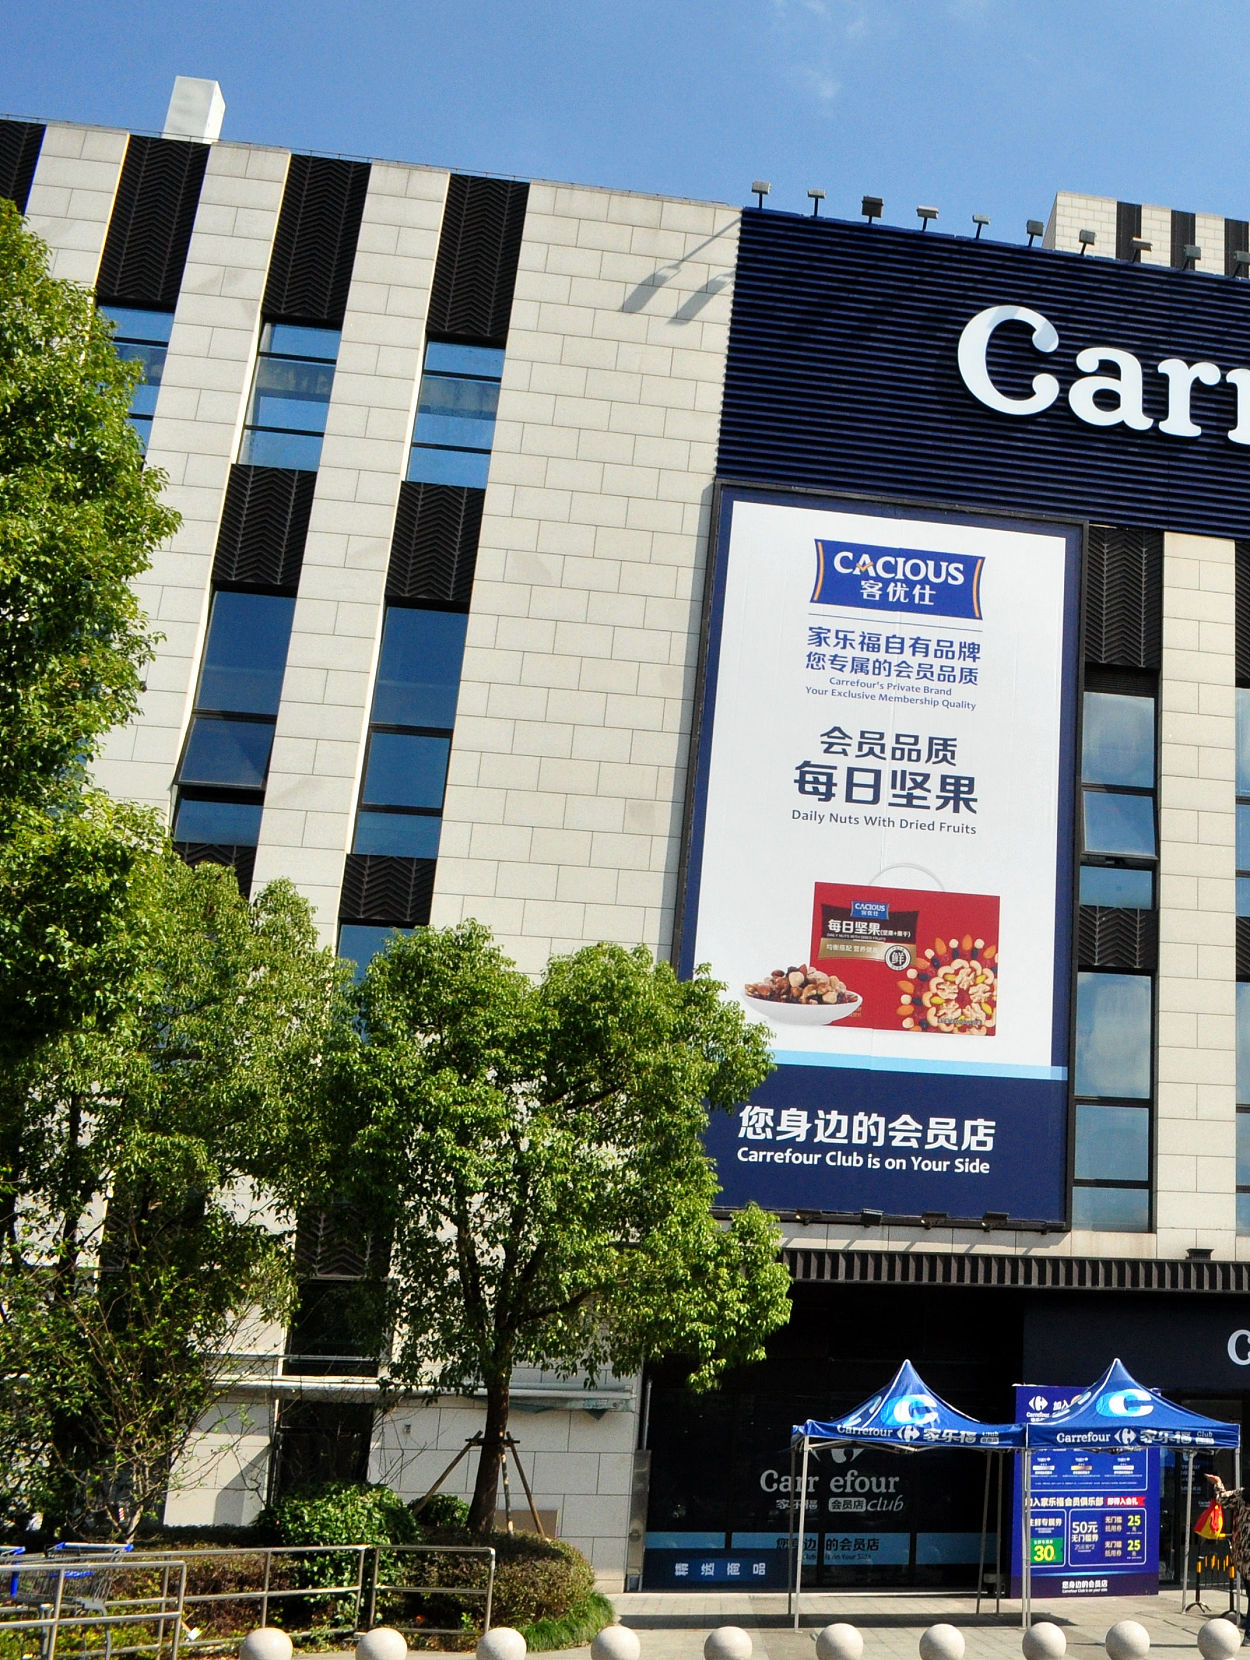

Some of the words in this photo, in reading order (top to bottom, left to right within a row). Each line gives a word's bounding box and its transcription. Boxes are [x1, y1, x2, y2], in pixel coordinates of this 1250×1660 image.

[833, 551, 964, 585] CACIOUS
[860, 579, 936, 606] 客优仕
[807, 627, 981, 663] 家乐福自有品牌
[806, 652, 979, 686] 您专属的会员品质
[829, 677, 884, 690] Carrefour's
[887, 683, 921, 693] Private
[923, 686, 951, 696] Brand
[806, 686, 828, 696] Your
[831, 689, 875, 700] Exclusive
[879, 694, 939, 707] Membership
[942, 700, 976, 711] Quality
[820, 726, 958, 766] 会员品质
[793, 760, 978, 815] 每日坚果
[792, 810, 824, 823] Daily
[830, 813, 859, 825] Nuts
[864, 816, 895, 828] With
[900, 819, 935, 831] Dried
[940, 822, 976, 834] Fruits
[855, 903, 885, 911] CACIOUS
[828, 919, 881, 936] 每日坚果
[738, 1105, 996, 1152] 您身边的会员店
[737, 1147, 821, 1165] Carrefour
[826, 1151, 863, 1167] Club
[868, 1154, 880, 1169] is
[885, 1158, 906, 1170] on
[911, 1156, 950, 1172] Your
[954, 1158, 989, 1174] Side
[837, 1425, 893, 1437] Carrefour
[1057, 1432, 1110, 1443] Carrefour
[867, 1494, 904, 1512] club
[1072, 1521, 1098, 1533] 50元
[1128, 1515, 1141, 1526] 25
[1034, 1545, 1054, 1561] 30
[1128, 1540, 1140, 1551] 25
